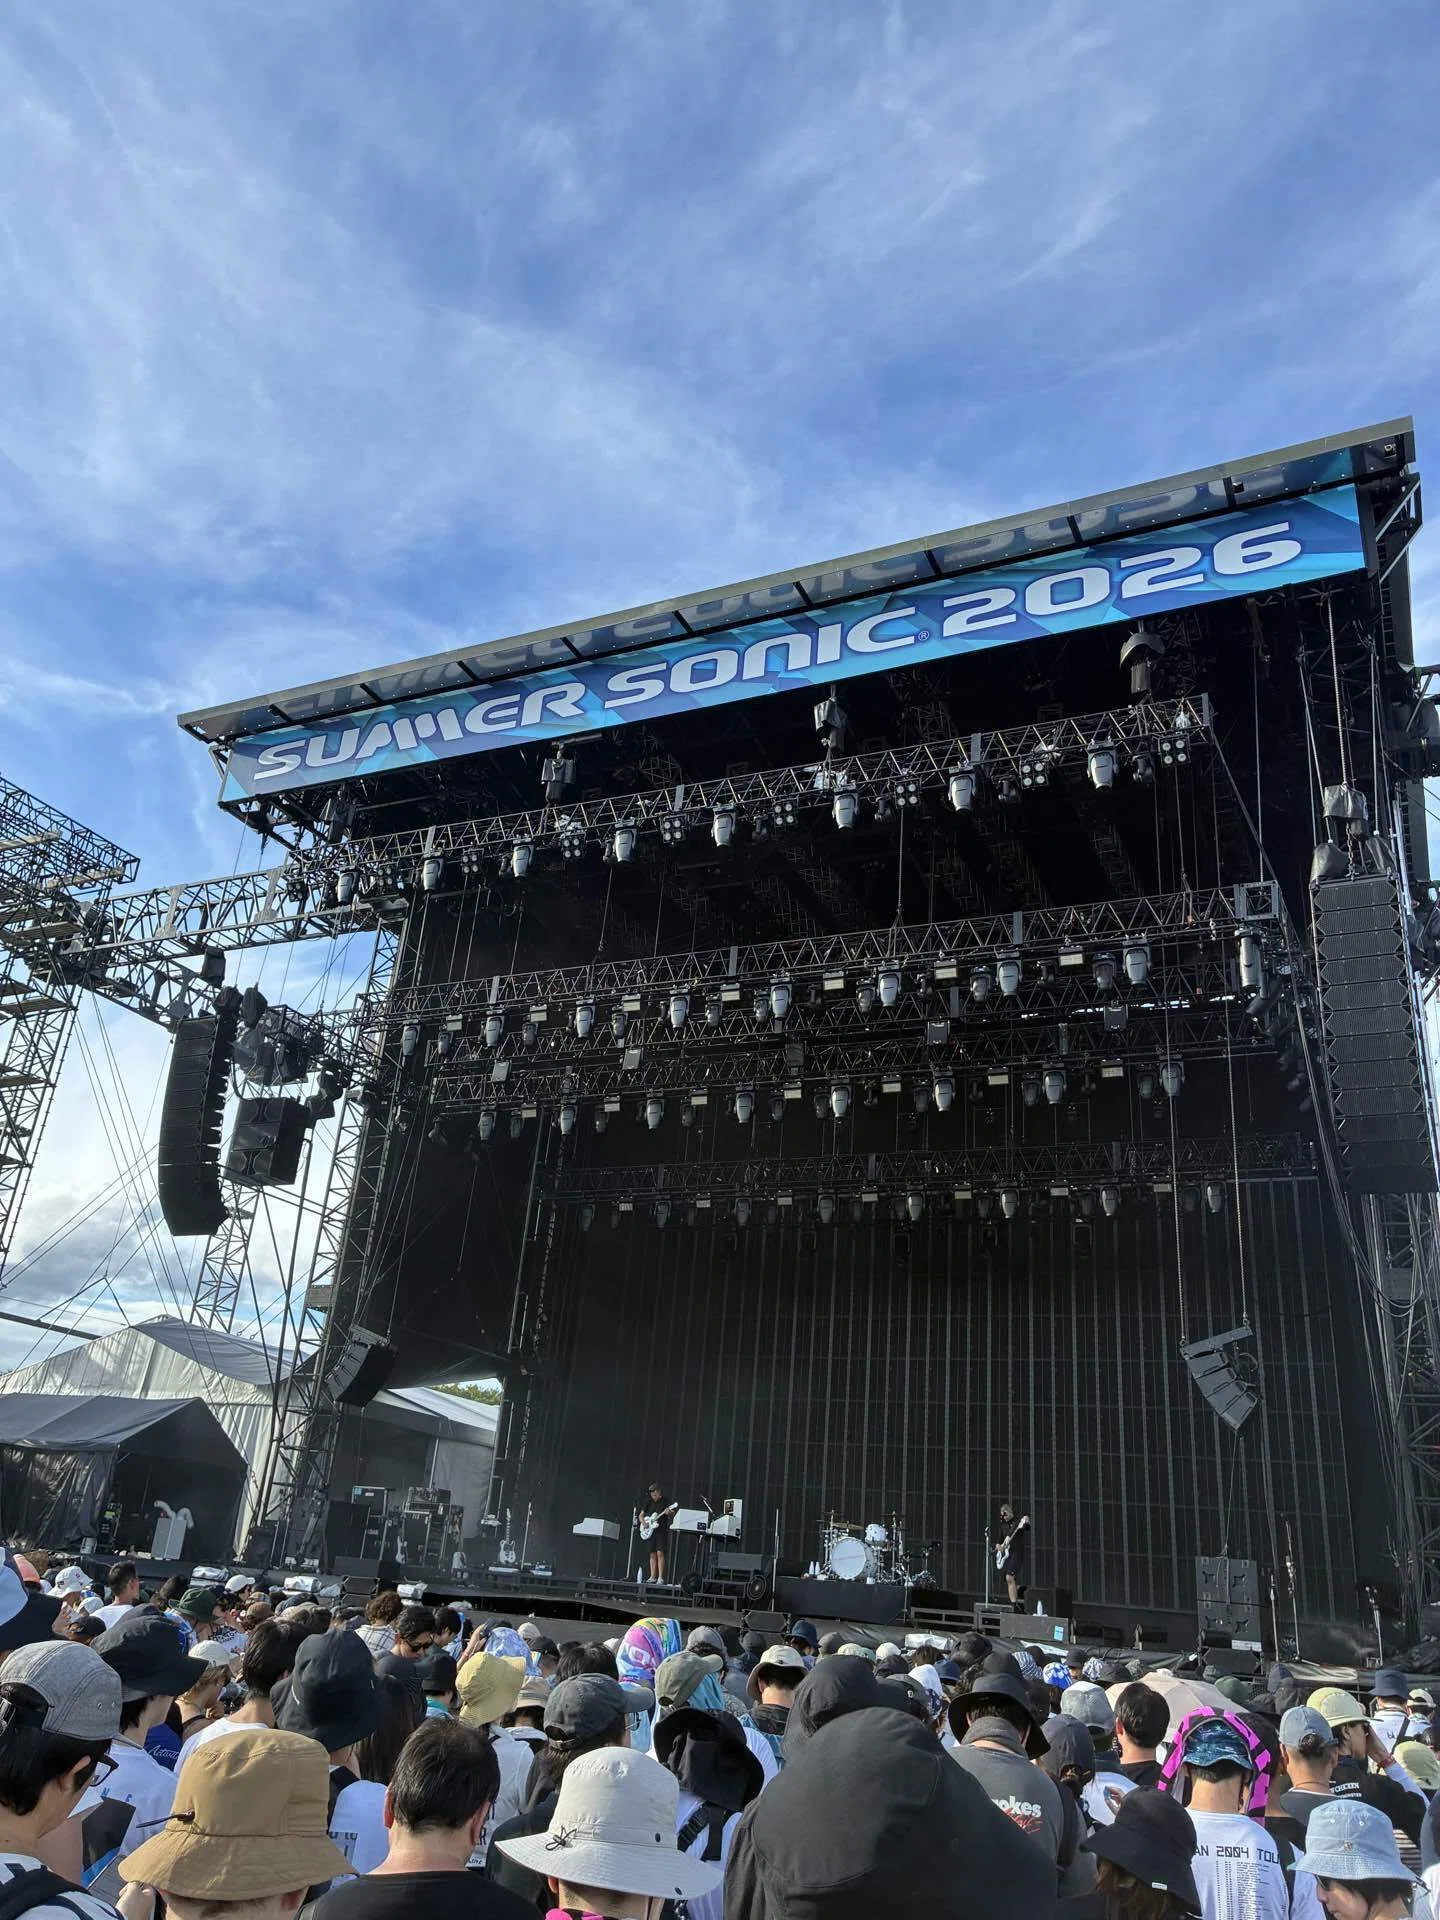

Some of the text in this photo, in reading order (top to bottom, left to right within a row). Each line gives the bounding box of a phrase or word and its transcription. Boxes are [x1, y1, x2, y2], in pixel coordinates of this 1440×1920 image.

[256, 682, 587, 779] SUMMER
[943, 521, 1303, 637] 2026
[1216, 1845, 1250, 1859] 2004
